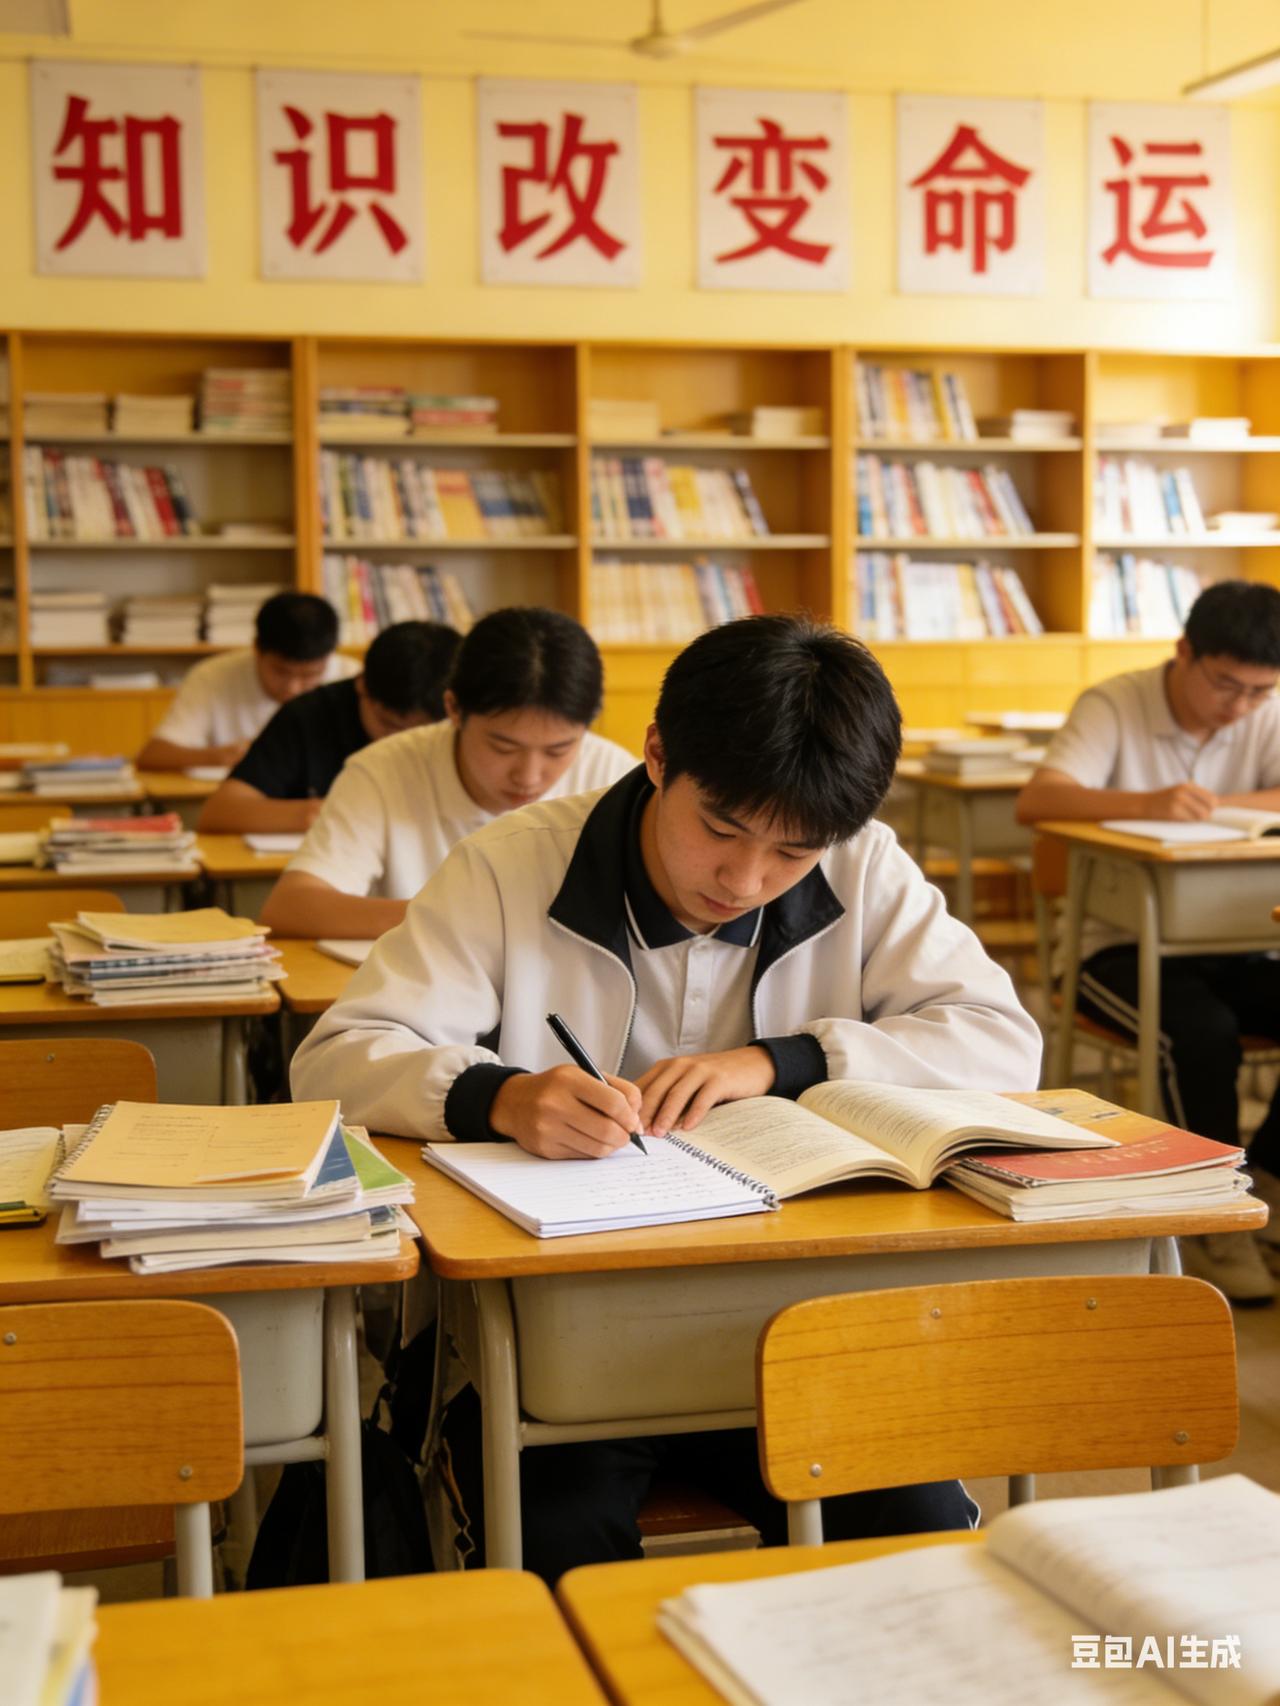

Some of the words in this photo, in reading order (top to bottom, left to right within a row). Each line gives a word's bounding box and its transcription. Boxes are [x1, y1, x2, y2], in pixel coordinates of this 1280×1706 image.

[52, 94, 1215, 274] 知识改变命运
